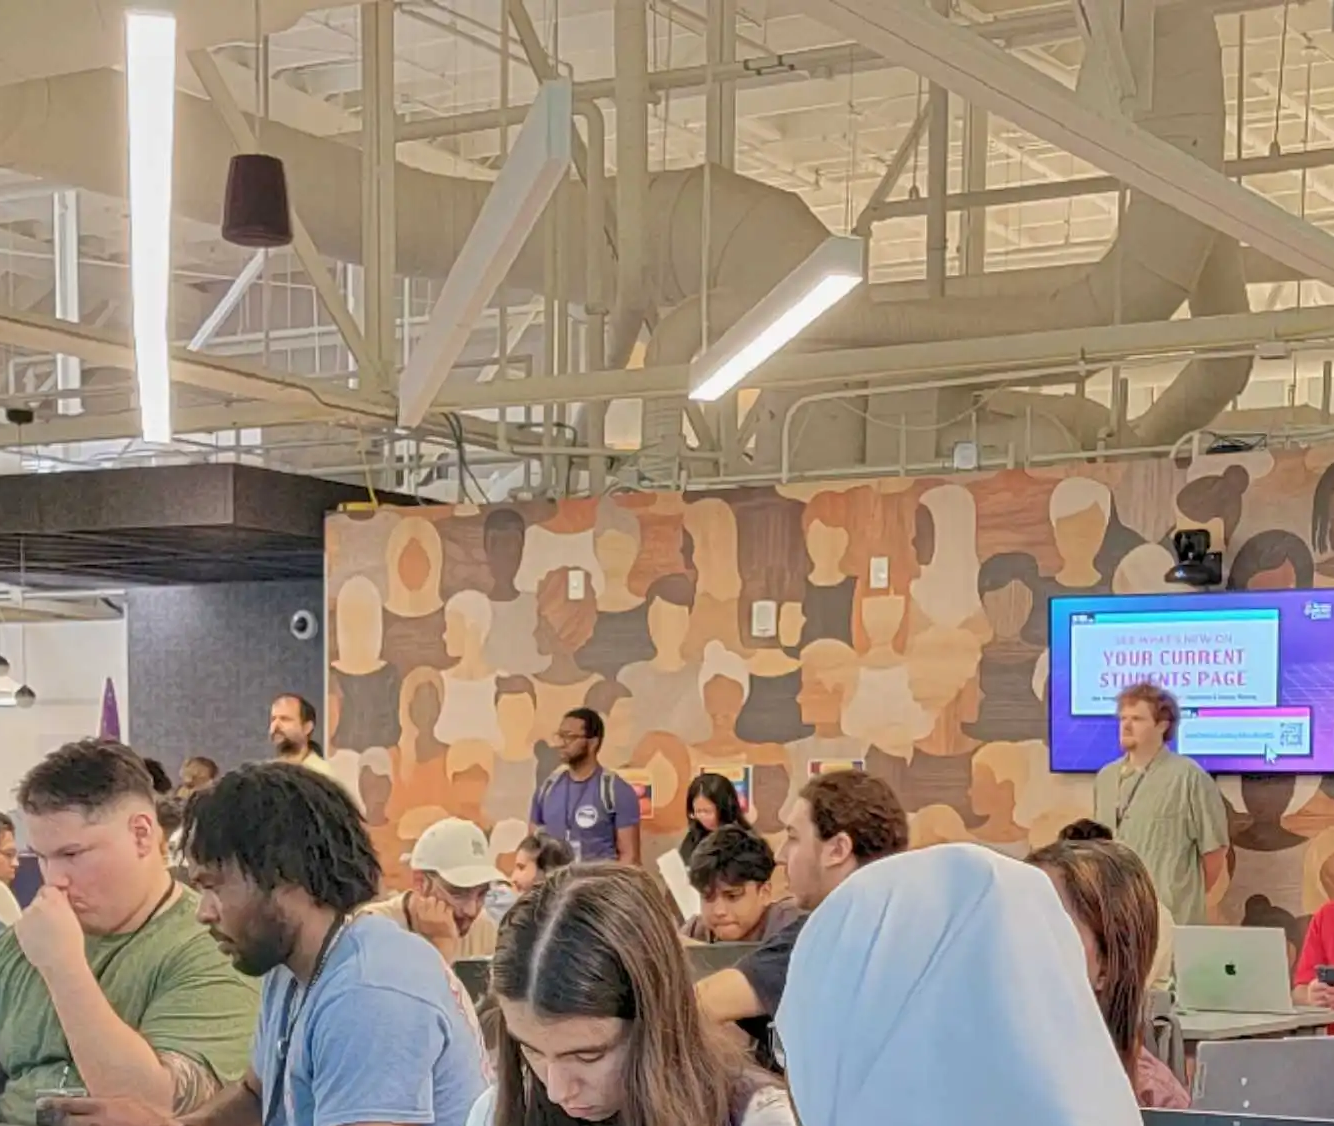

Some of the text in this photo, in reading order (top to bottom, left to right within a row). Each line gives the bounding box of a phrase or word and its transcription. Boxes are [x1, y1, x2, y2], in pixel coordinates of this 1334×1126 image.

[1103, 648, 1245, 667] YOUR CURRENT
[1198, 670, 1247, 687] PAGE
